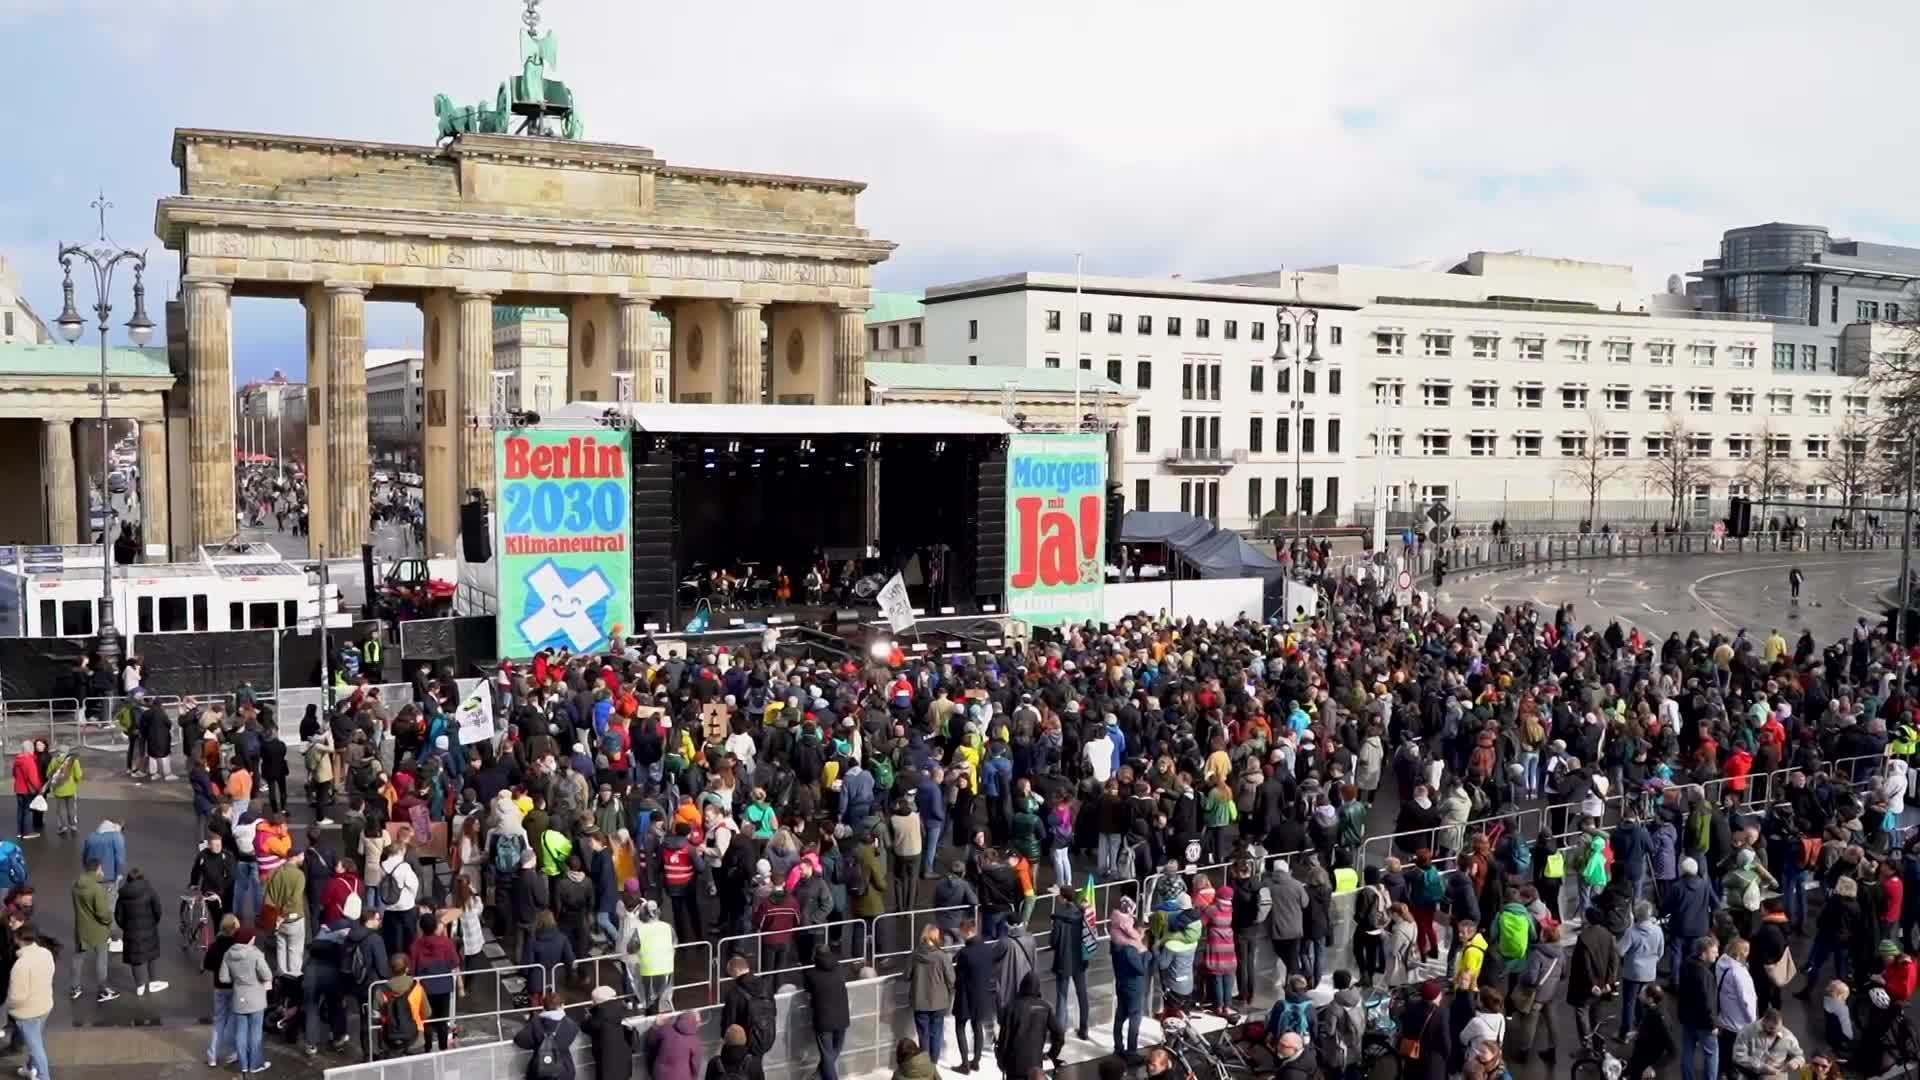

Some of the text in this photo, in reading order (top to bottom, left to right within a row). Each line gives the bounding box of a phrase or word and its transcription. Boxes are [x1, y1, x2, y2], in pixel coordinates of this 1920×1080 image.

[505, 437, 624, 478] Berlin
[1014, 458, 1101, 493] Morgen
[504, 481, 625, 533] 2030
[506, 534, 624, 555] Klimaneutral
[1012, 496, 1101, 588] Ja!
